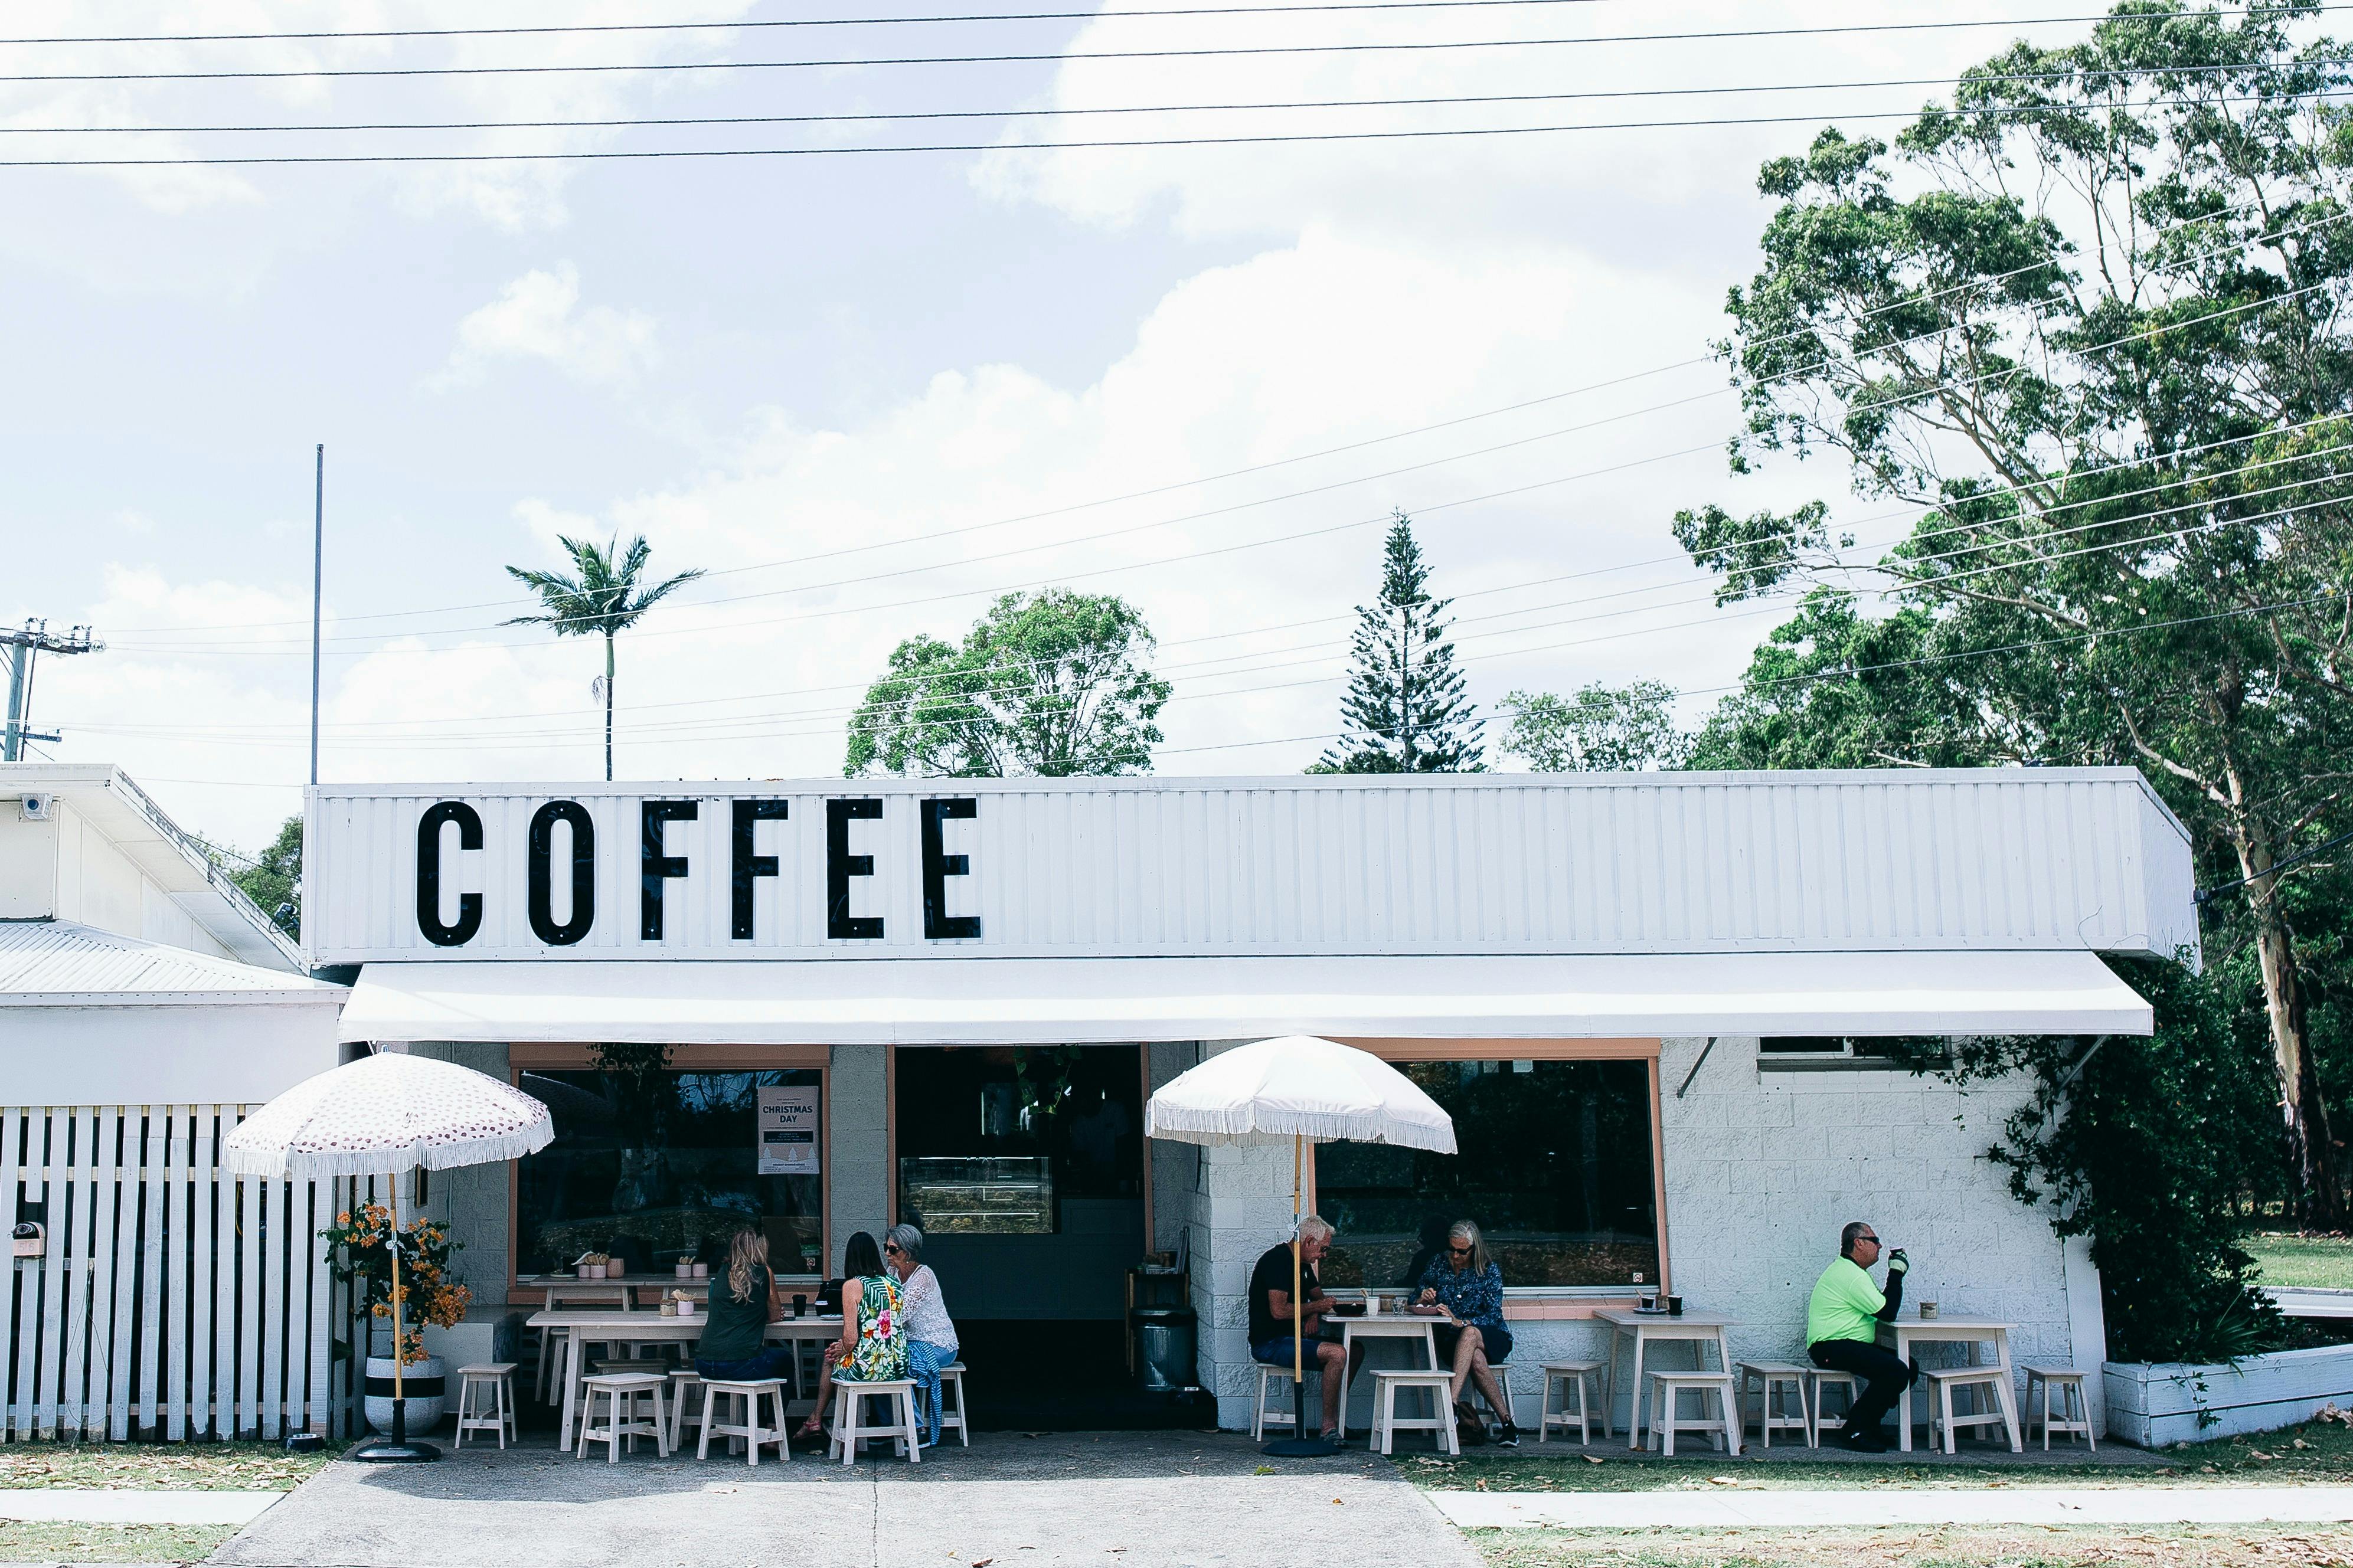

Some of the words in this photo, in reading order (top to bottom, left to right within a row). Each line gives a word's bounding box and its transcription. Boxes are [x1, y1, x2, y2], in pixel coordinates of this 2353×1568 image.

[416, 797, 981, 946] COFFEE
[763, 1105, 813, 1114] CHRISTMAS
[19, 1242, 34, 1252] 56
